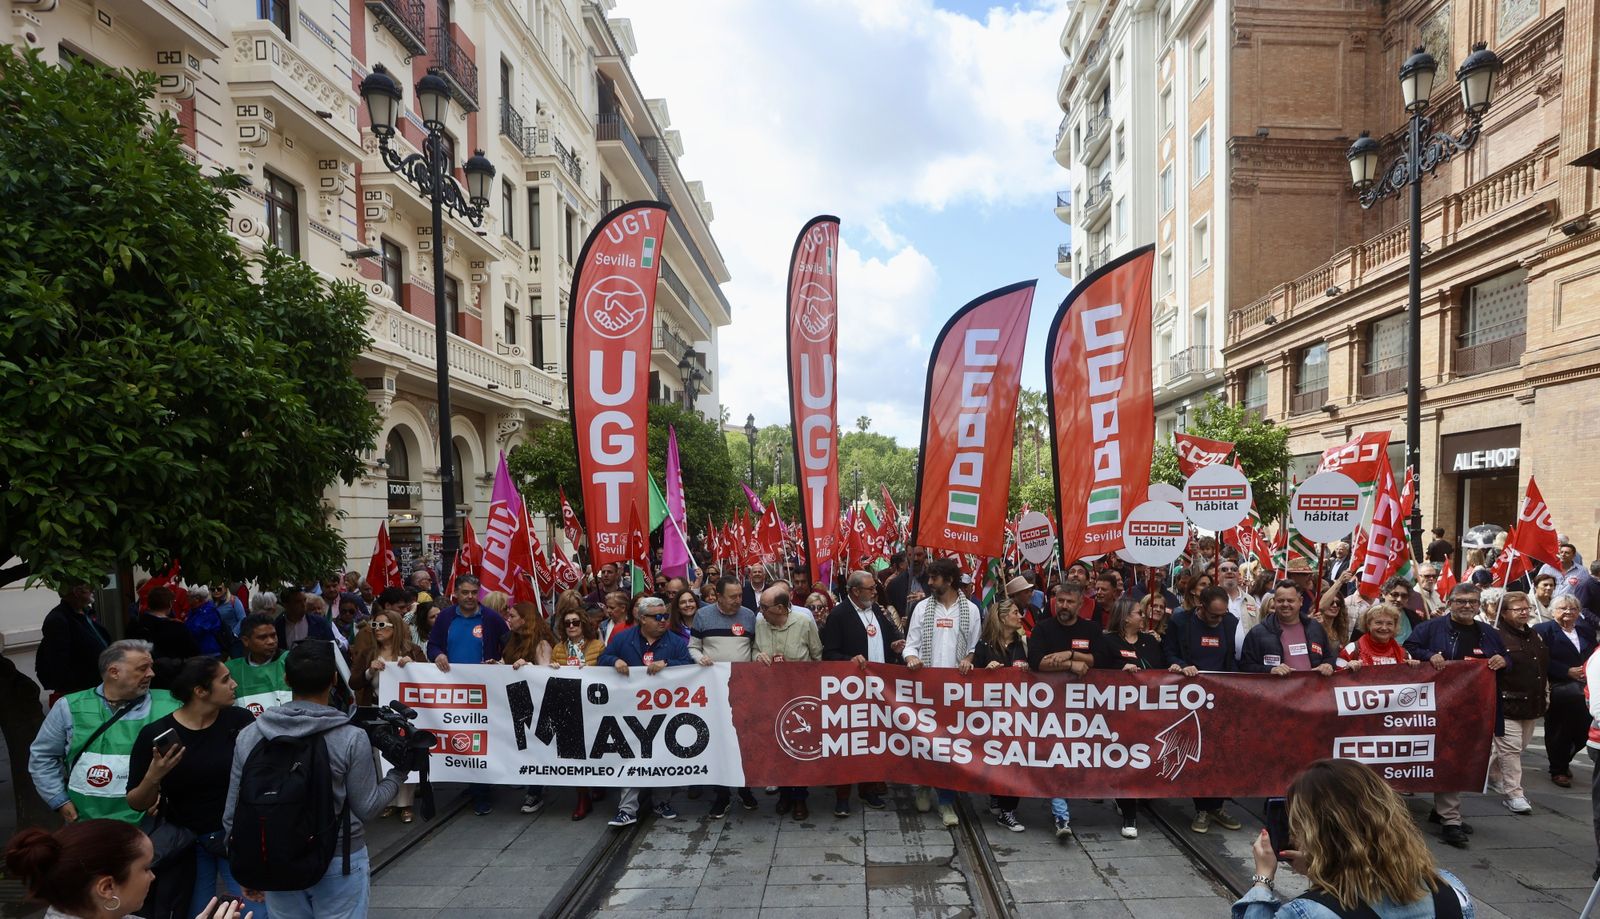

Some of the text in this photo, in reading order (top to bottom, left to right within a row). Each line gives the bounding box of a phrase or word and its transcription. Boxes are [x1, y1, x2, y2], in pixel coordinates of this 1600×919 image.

[604, 209, 652, 245] UGT
[804, 223, 830, 253] UGT
[595, 252, 636, 268] Sevilla
[798, 259, 824, 275] Sevilla
[1080, 303, 1125, 483] CCOO
[948, 328, 1000, 488] CCOO
[588, 350, 637, 524] UGT
[800, 352, 834, 529] UGT
[1452, 448, 1519, 472] ALE-HOP
[389, 484, 421, 495] TORO TORO
[1190, 488, 1228, 498] CCOO
[1195, 501, 1239, 511] hábitat
[1300, 497, 1339, 507] CCOO
[1304, 511, 1350, 522] hábitat
[1519, 496, 1555, 532] UG
[943, 528, 979, 543] Sevilla
[1021, 530, 1041, 540] CCOO
[1131, 524, 1167, 533] CCOO
[1024, 538, 1048, 550] hábitat
[1084, 529, 1123, 544] Sevilla
[1135, 536, 1176, 547] hábitat
[598, 543, 626, 555] Sevill
[404, 686, 469, 705] CCOO
[636, 686, 708, 711] 2024
[820, 675, 1215, 711] POR EL PLENO EMPLEO:
[1342, 689, 1395, 712] UGT
[442, 712, 489, 725] Sevilla
[820, 703, 1120, 743] MENOS JORNADA,
[1383, 714, 1437, 728] Sevilla
[820, 731, 1152, 769] MEJORES SALARIOS
[1338, 740, 1412, 759] CCOO
[444, 755, 488, 770] Sevilla
[87, 766, 112, 779] UGT
[518, 765, 615, 777] #PLENOEMPLEO
[626, 764, 709, 777] #1MAYO2024
[1384, 765, 1435, 780] Sevilla
